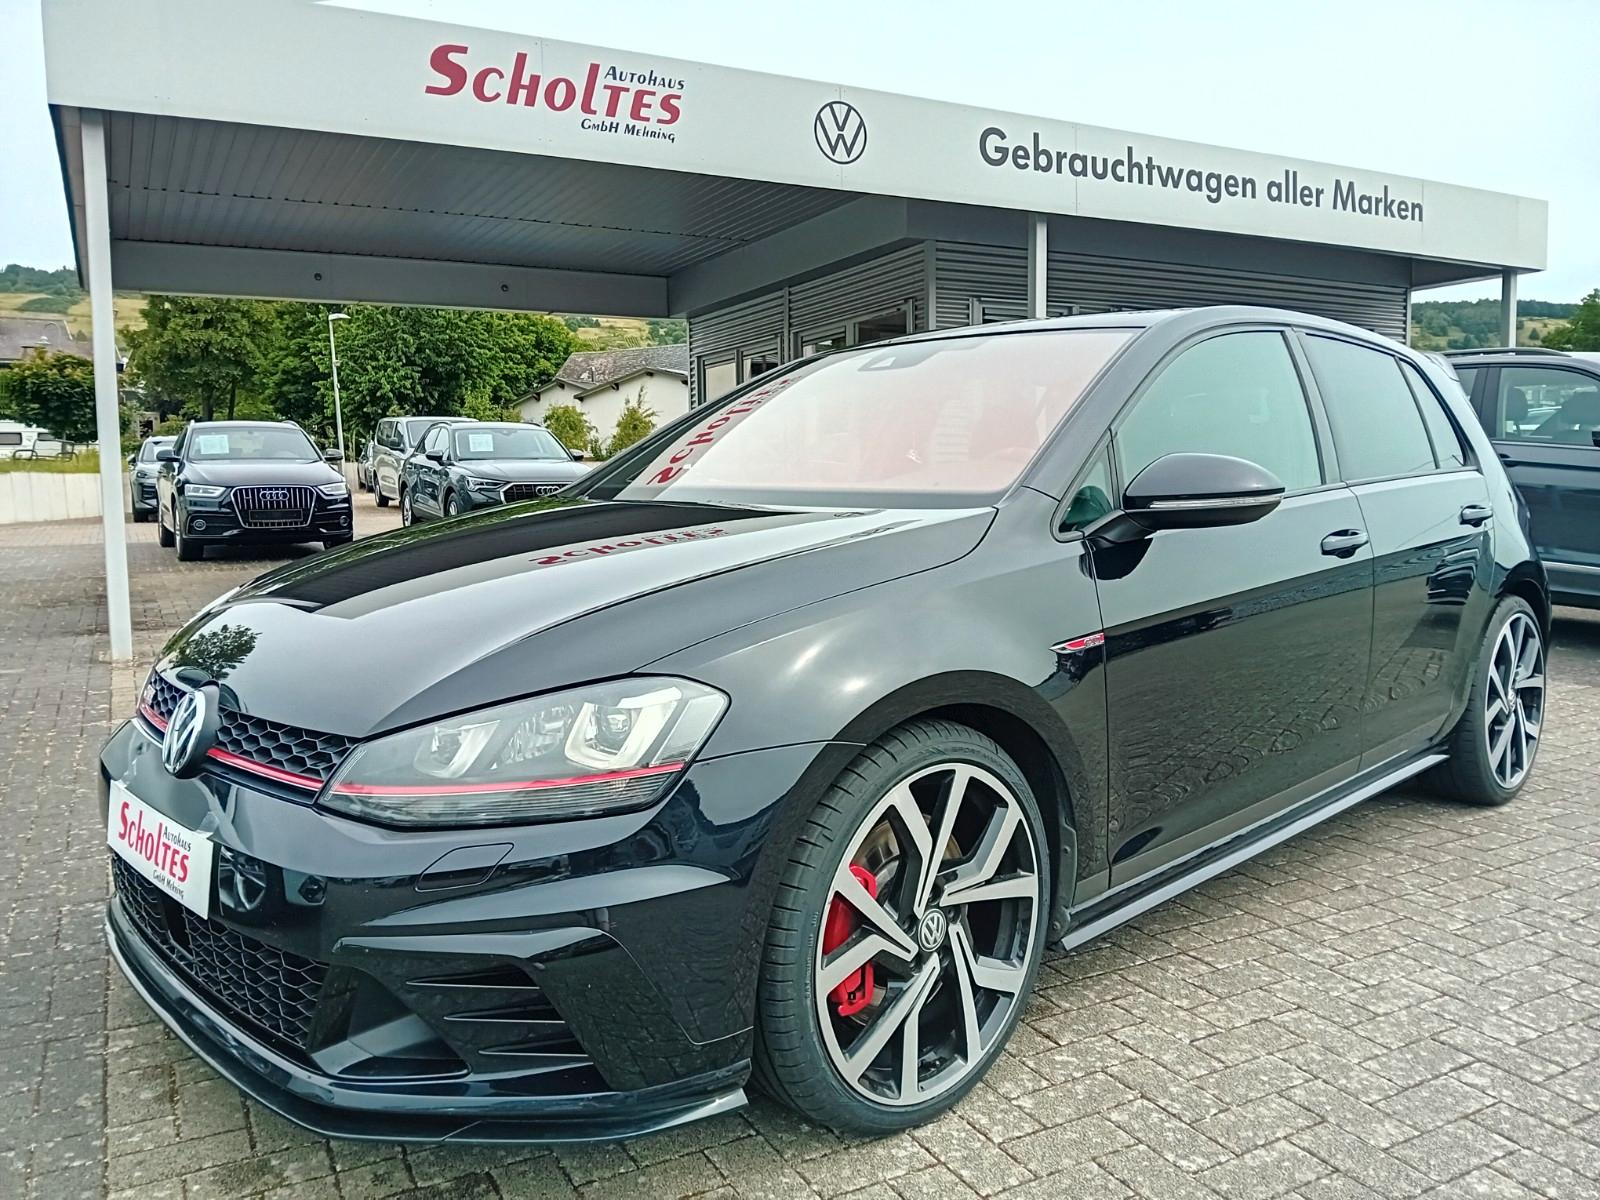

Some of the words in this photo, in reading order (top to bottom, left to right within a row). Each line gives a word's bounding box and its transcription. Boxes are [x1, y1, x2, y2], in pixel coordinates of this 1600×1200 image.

[814, 100, 867, 164] VW
[979, 126, 1256, 204] Gebrauchtwagen
[1267, 169, 1324, 208] aller
[1333, 179, 1423, 222] Marken
[918, 908, 947, 952] VW
